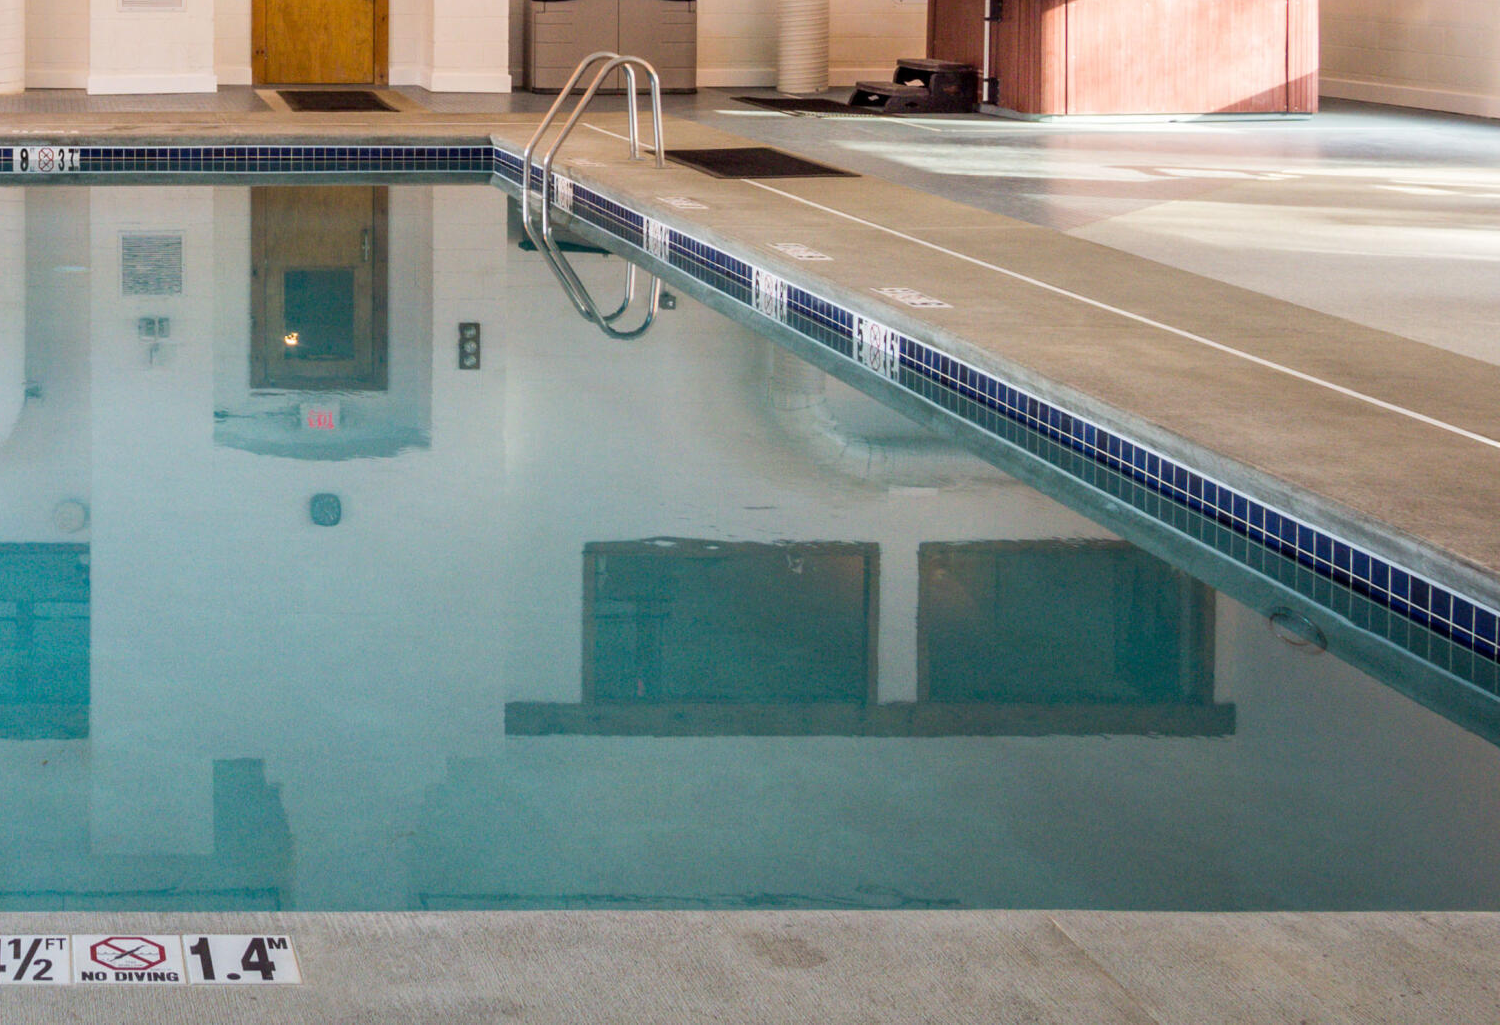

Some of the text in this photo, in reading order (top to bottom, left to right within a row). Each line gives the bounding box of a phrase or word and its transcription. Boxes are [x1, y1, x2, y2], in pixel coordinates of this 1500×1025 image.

[45, 938, 67, 950] FT
[266, 937, 288, 950] M
[81, 971, 179, 982] NO DIVING
